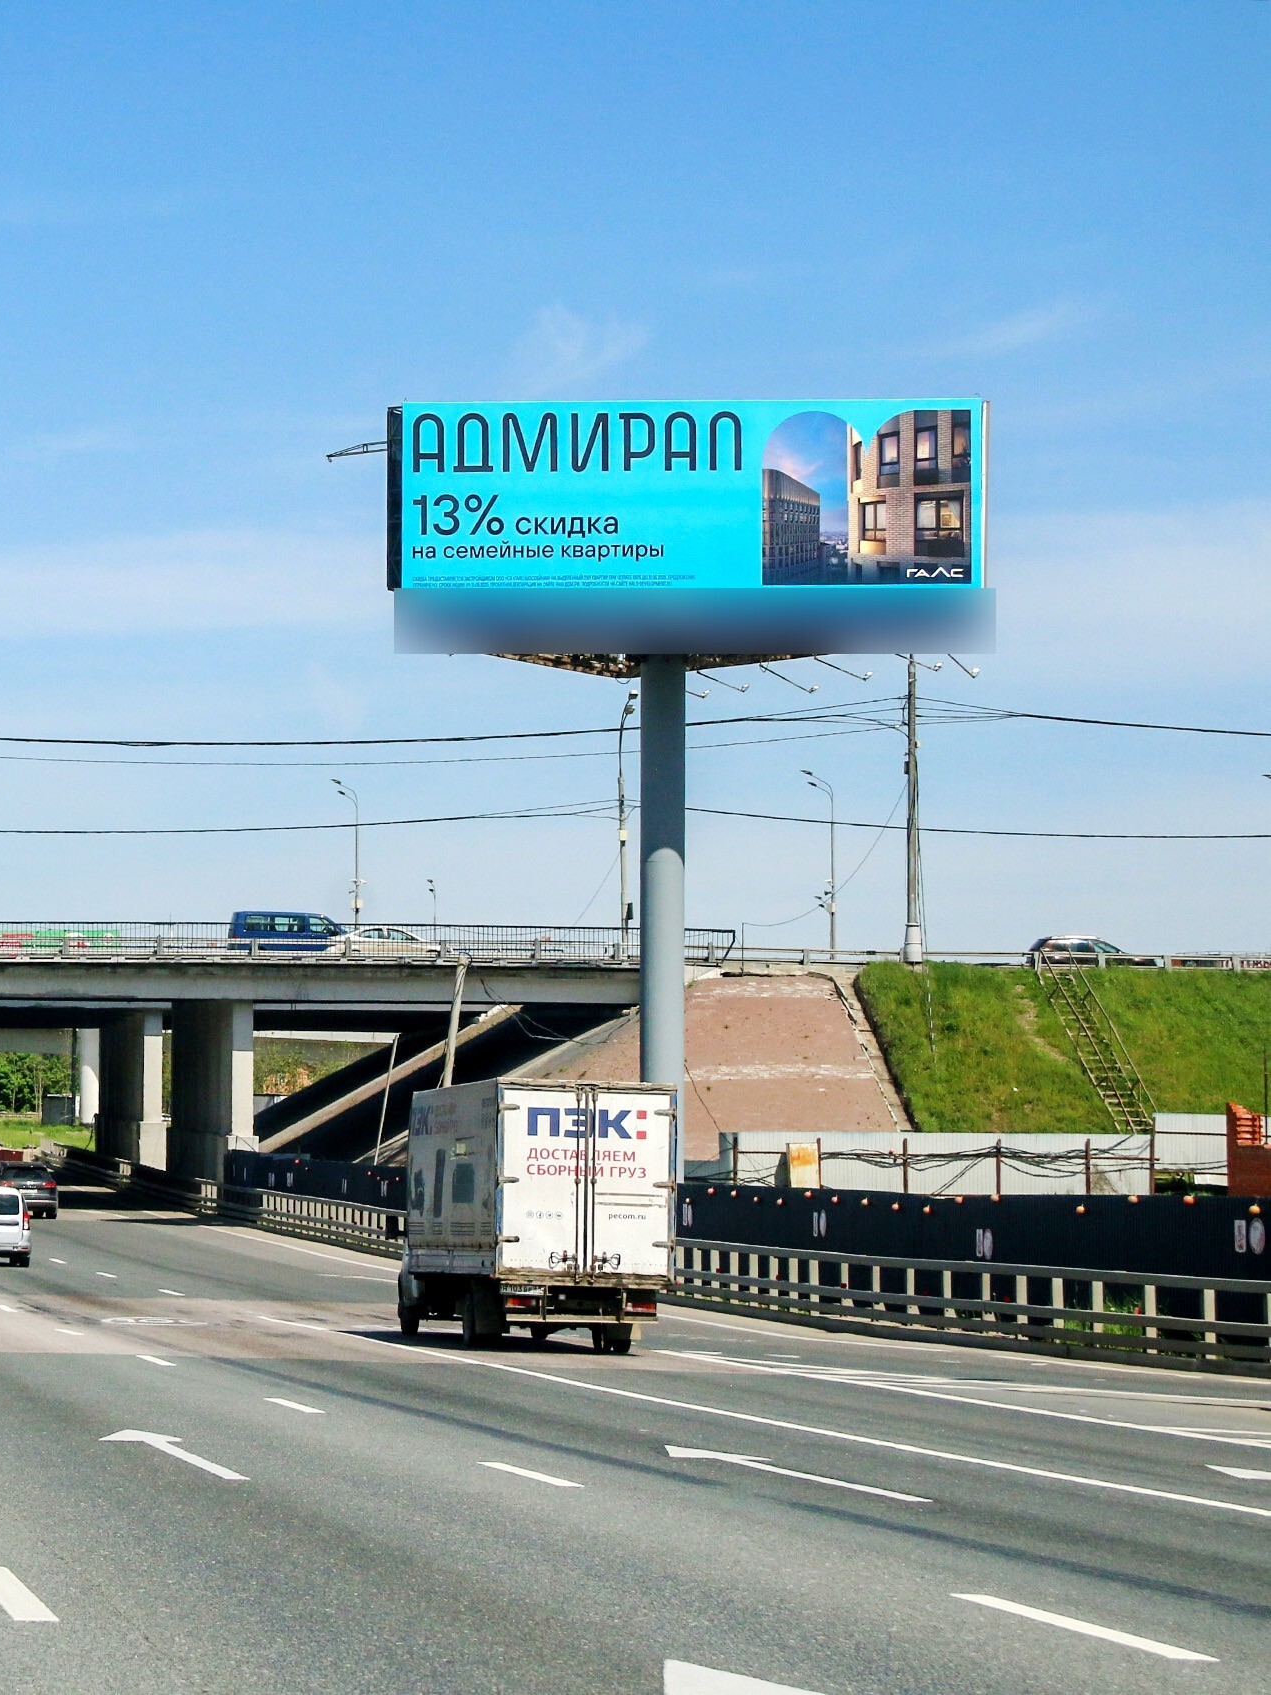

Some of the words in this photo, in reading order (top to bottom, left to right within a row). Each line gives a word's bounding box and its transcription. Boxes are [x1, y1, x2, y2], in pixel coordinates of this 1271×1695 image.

[412, 411, 743, 473] АДМИРАЛ
[412, 494, 505, 536] 13%
[515, 515, 619, 538] скидка
[412, 545, 436, 559] на
[443, 541, 554, 559] семейные
[561, 544, 665, 562] квартиры
[906, 566, 964, 578] ГАЛС
[526, 1147, 636, 1162] ДОСТАВЛЯЕМ
[526, 1163, 604, 1178] СБОРНЫЙ
[610, 1166, 647, 1179] ГРУЗ
[608, 1213, 647, 1221] pecom.ru
